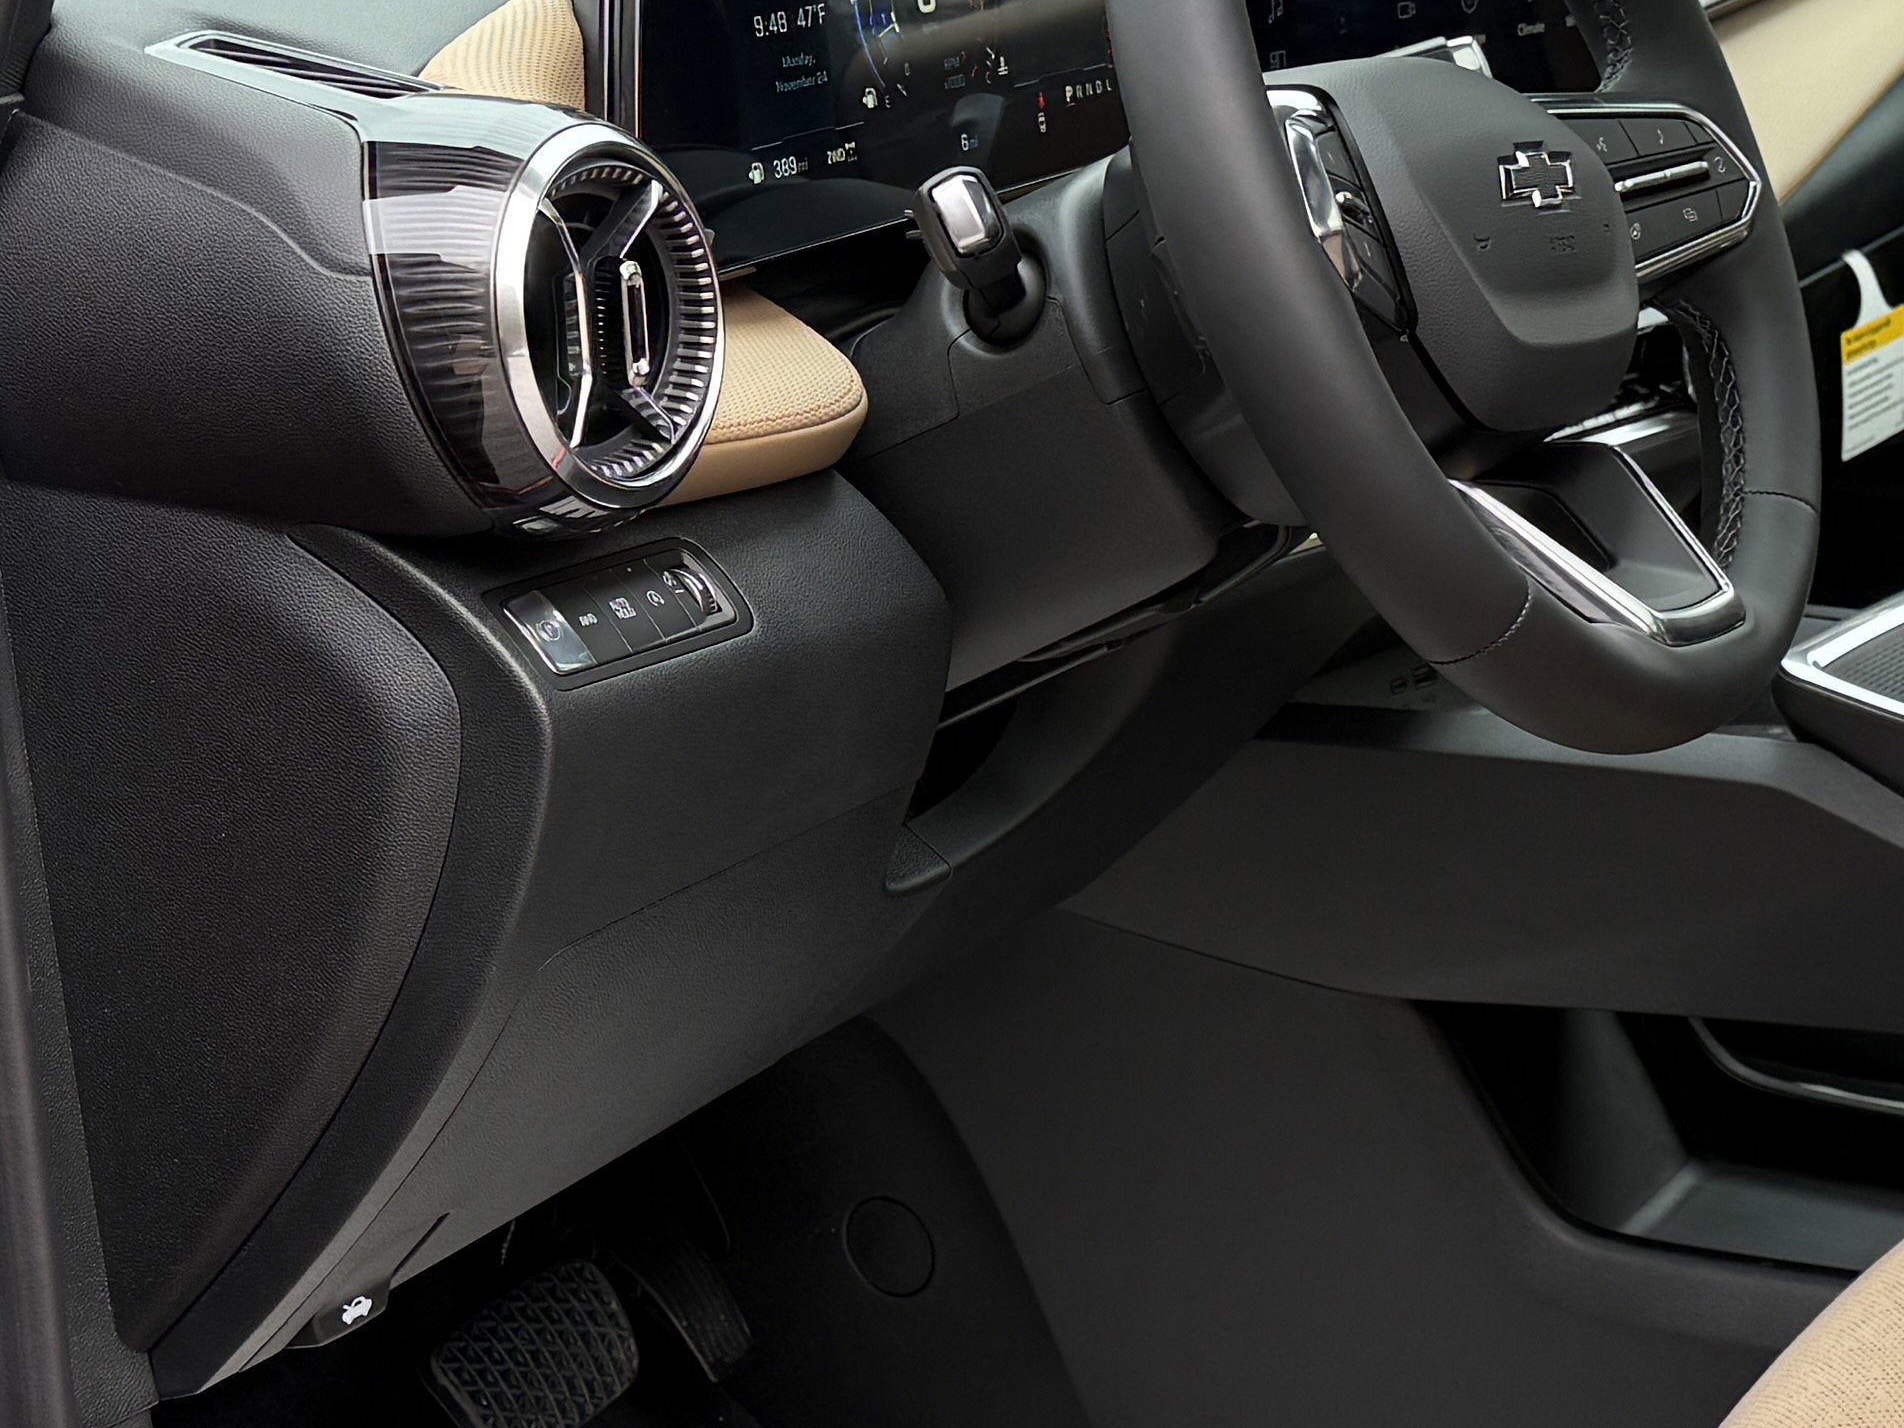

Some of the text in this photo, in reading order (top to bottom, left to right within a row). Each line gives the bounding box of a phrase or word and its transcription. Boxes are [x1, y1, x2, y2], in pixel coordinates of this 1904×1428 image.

[753, 3, 825, 38] 9:48 47°F
[775, 74, 816, 94] November
